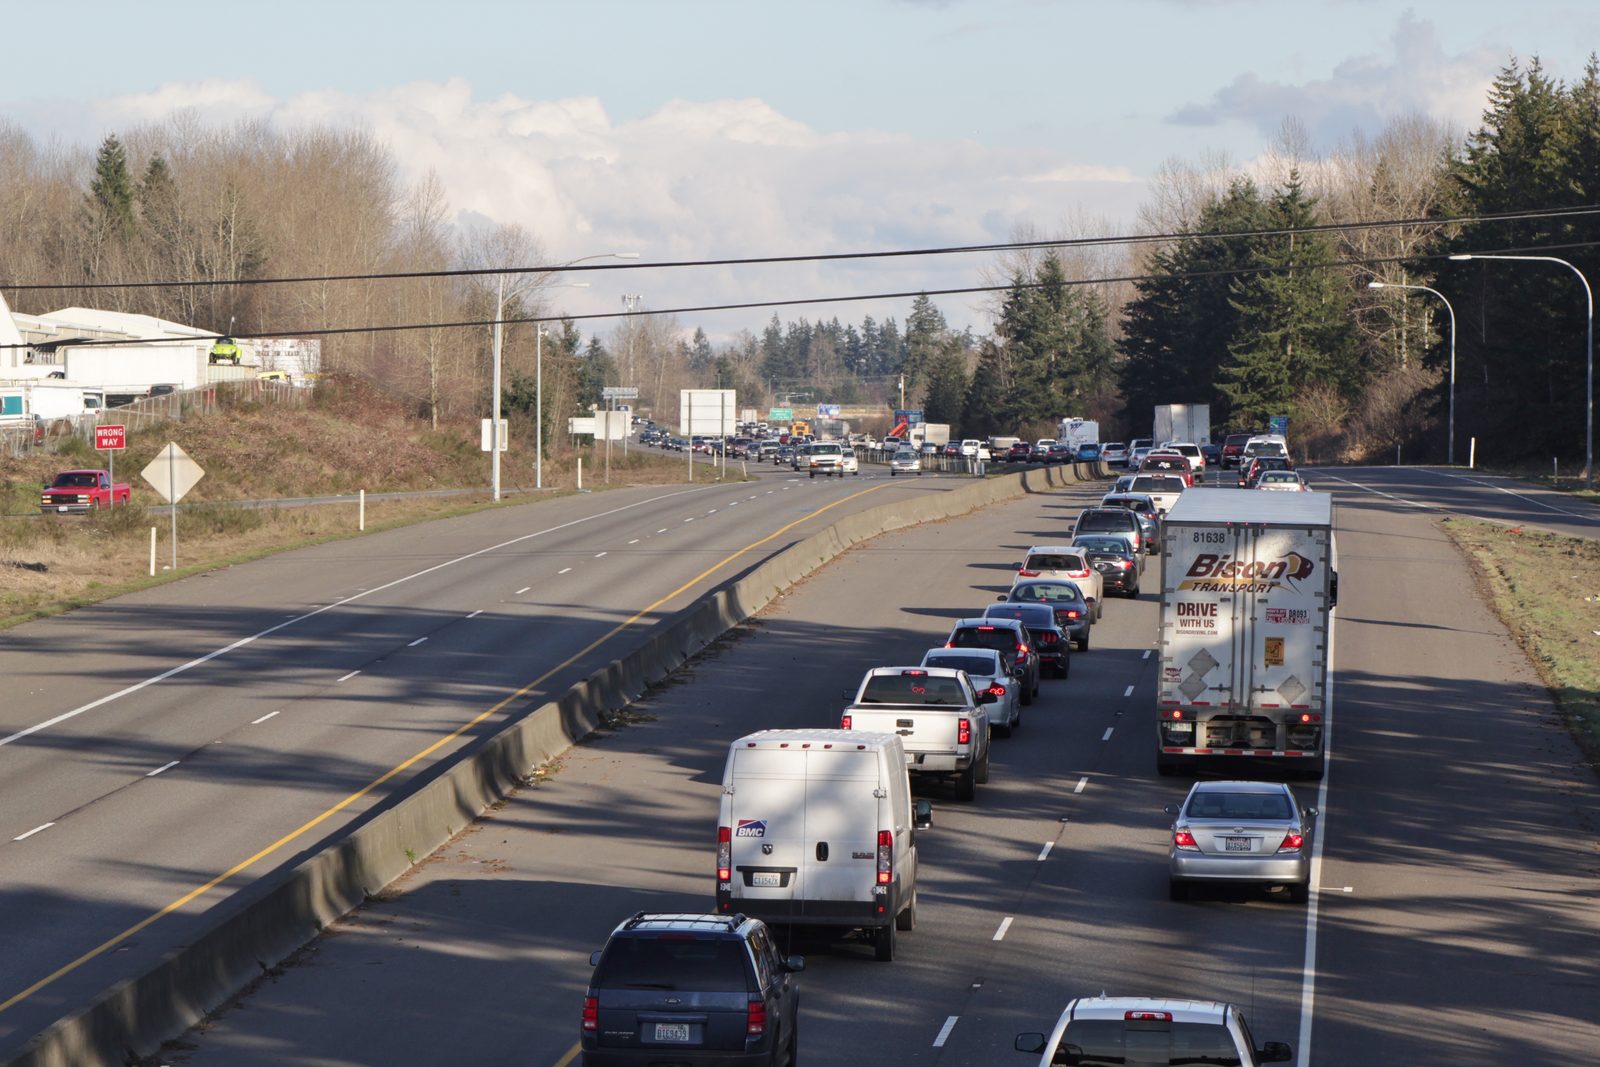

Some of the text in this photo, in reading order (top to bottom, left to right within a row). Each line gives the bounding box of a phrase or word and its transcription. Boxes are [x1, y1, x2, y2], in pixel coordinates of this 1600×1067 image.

[97, 429, 123, 437] WRONG
[102, 438, 118, 446] WAY
[1193, 532, 1225, 543] 81638
[1186, 554, 1288, 579] Bison
[1192, 582, 1275, 593] TRANSPORT
[1177, 602, 1218, 617] DRIVE
[1180, 619, 1215, 628] WITH US
[738, 827, 764, 837] BMC
